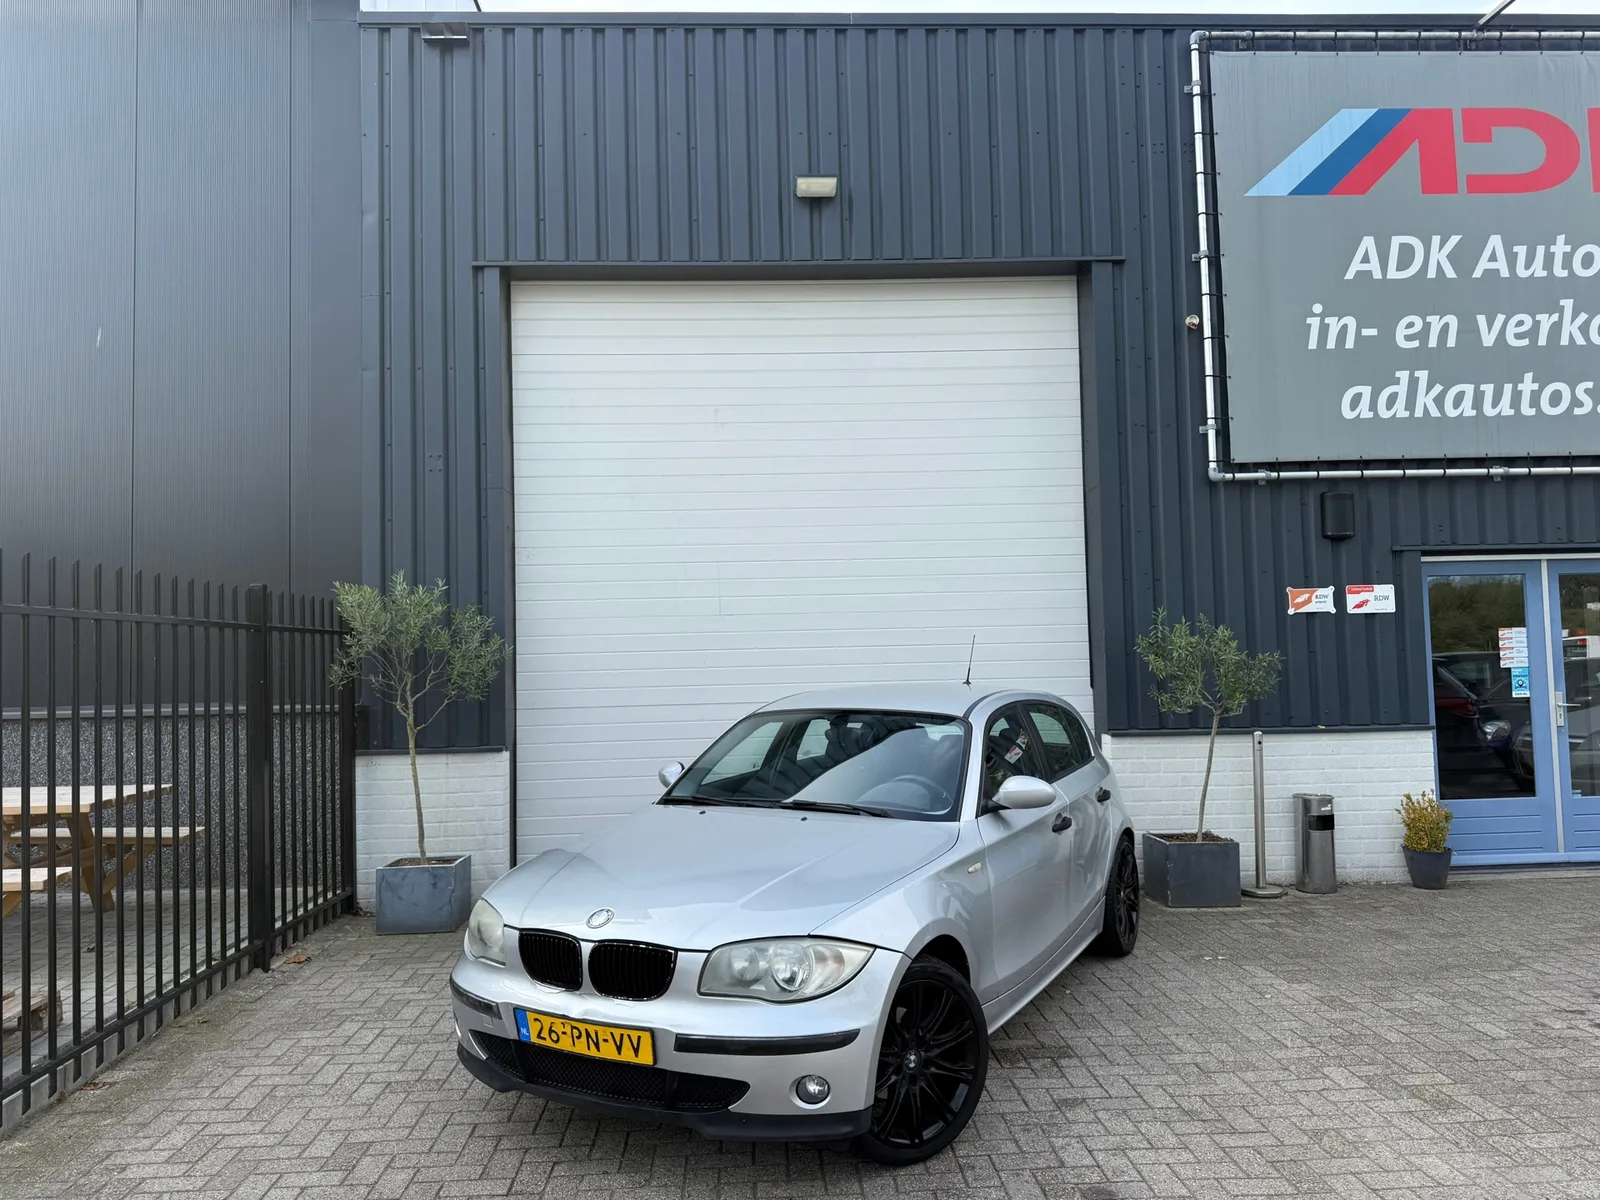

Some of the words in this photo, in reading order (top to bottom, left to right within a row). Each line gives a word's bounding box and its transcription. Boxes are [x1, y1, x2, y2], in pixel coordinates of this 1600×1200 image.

[1343, 234, 1463, 281] ADK
[1305, 302, 1378, 350] in-
[1395, 313, 1459, 349] en
[1373, 594, 1390, 602] RDW
[520, 1026, 530, 1036] NL
